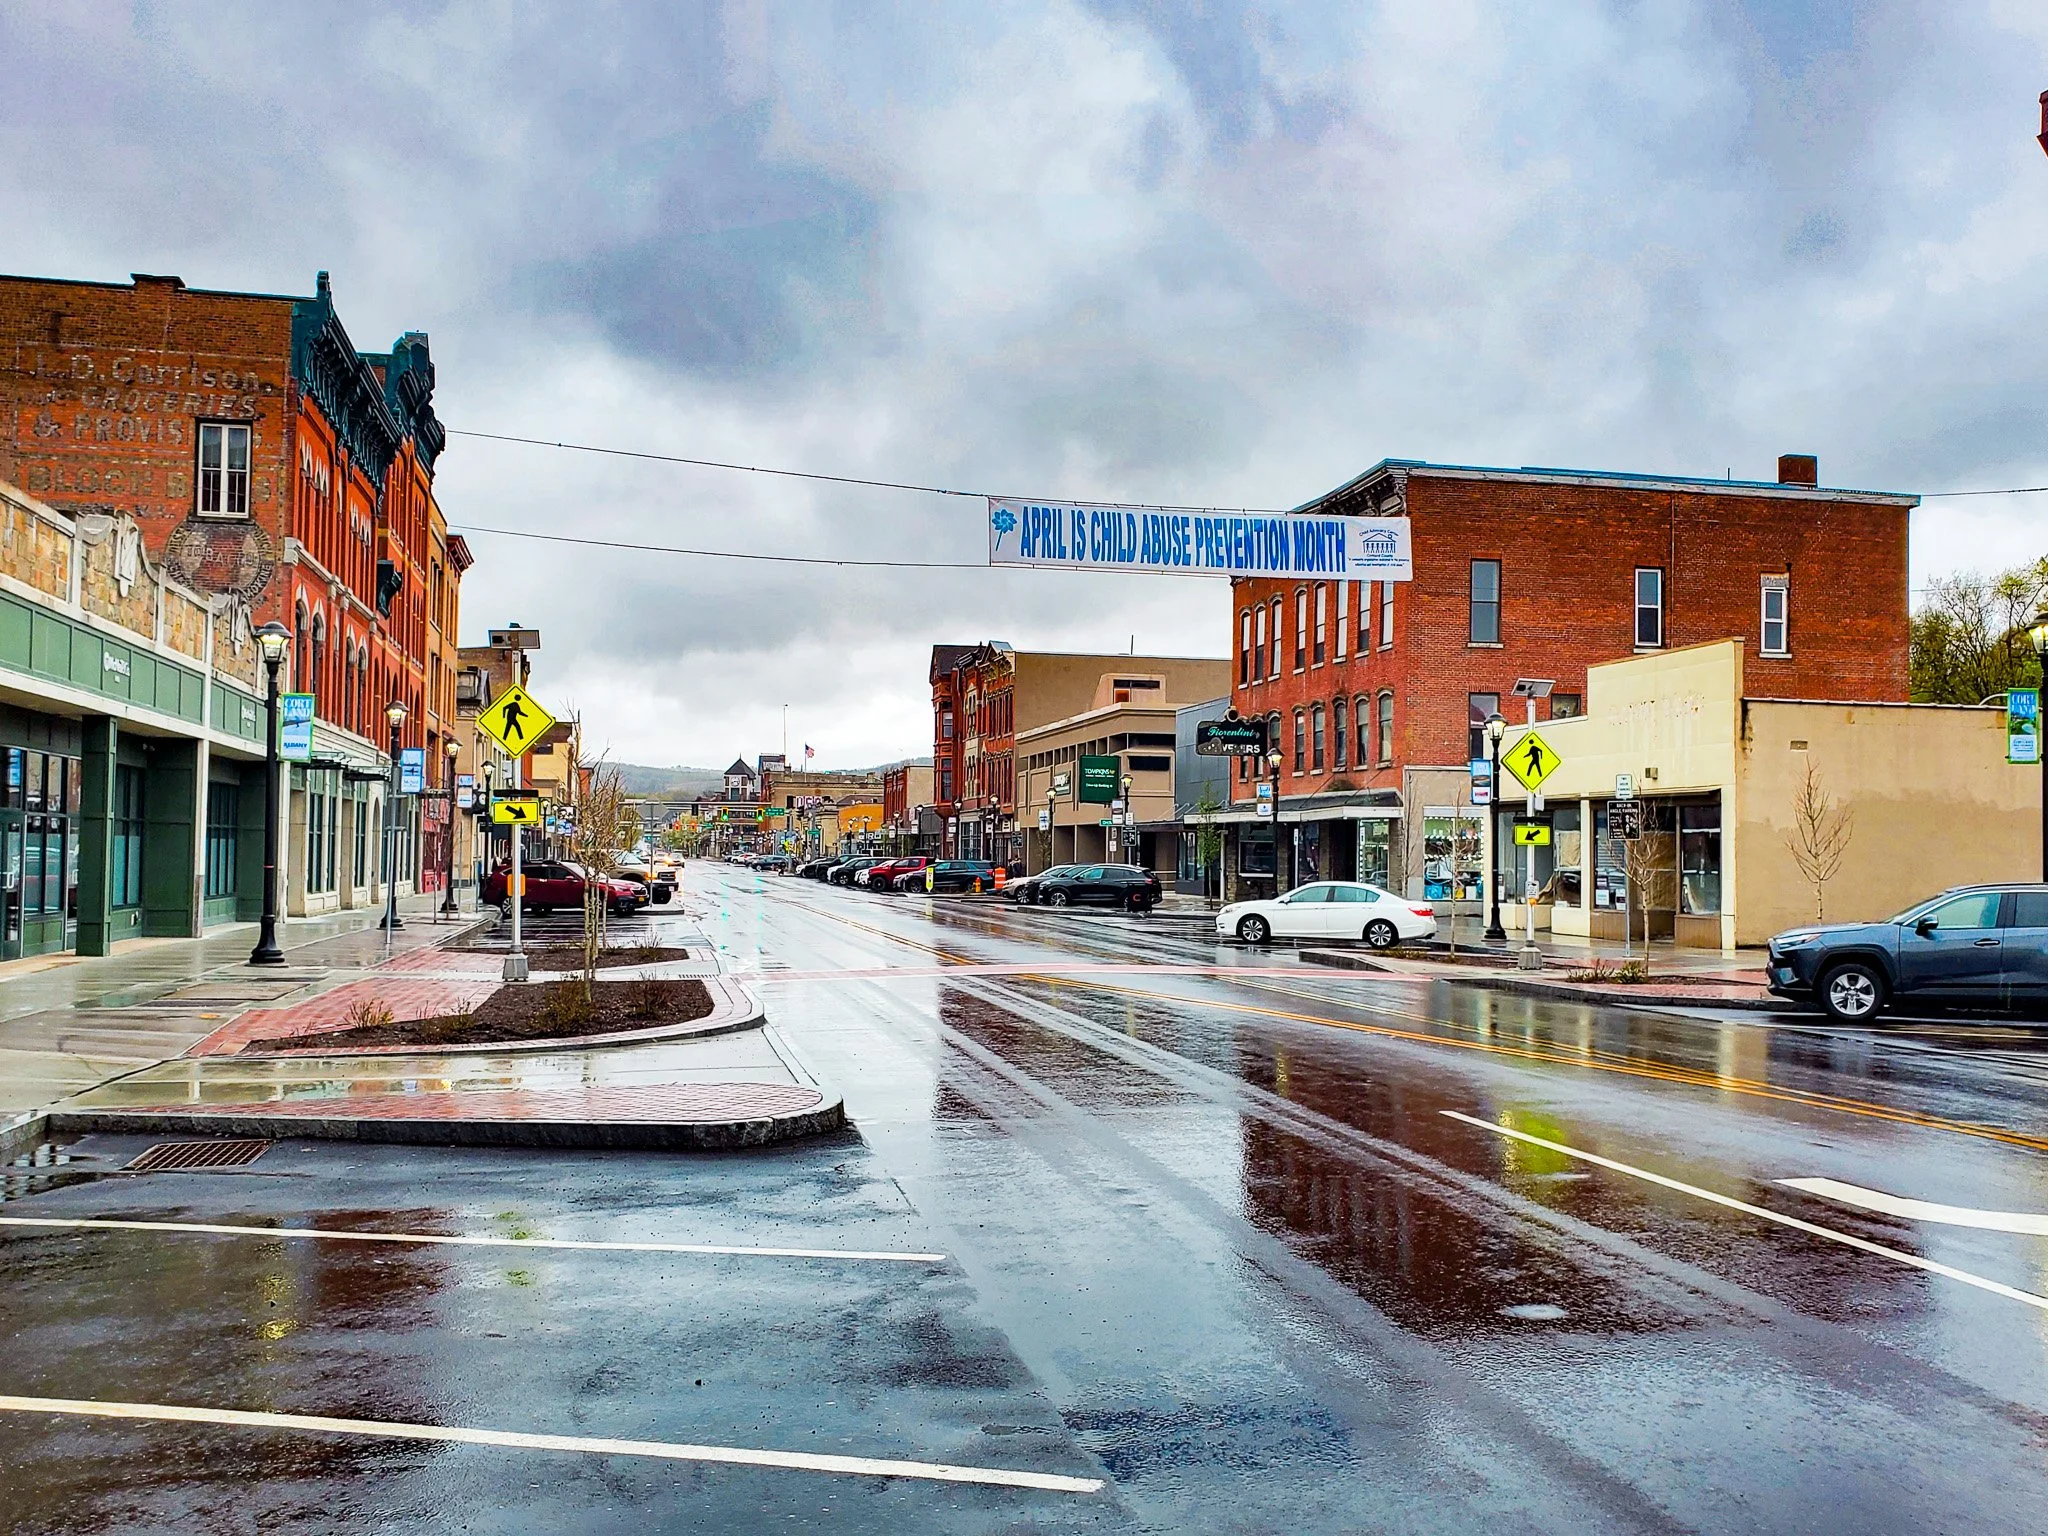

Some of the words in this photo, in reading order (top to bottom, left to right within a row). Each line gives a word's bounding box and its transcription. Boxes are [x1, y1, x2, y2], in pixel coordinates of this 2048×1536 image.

[34, 408, 61, 438] &
[1020, 506, 1067, 560] APRIL
[1071, 509, 1086, 561] IS
[1091, 510, 1137, 563] CHILD
[1140, 514, 1191, 567] ABUSE
[1194, 517, 1289, 572] PREVENTION
[1293, 520, 1346, 573] MONTH
[285, 698, 312, 708] CORT
[2012, 694, 2035, 705] CORT
[284, 708, 311, 718] LAND
[2011, 705, 2036, 715] LAND
[1084, 768, 1110, 776] TOMPKINS
